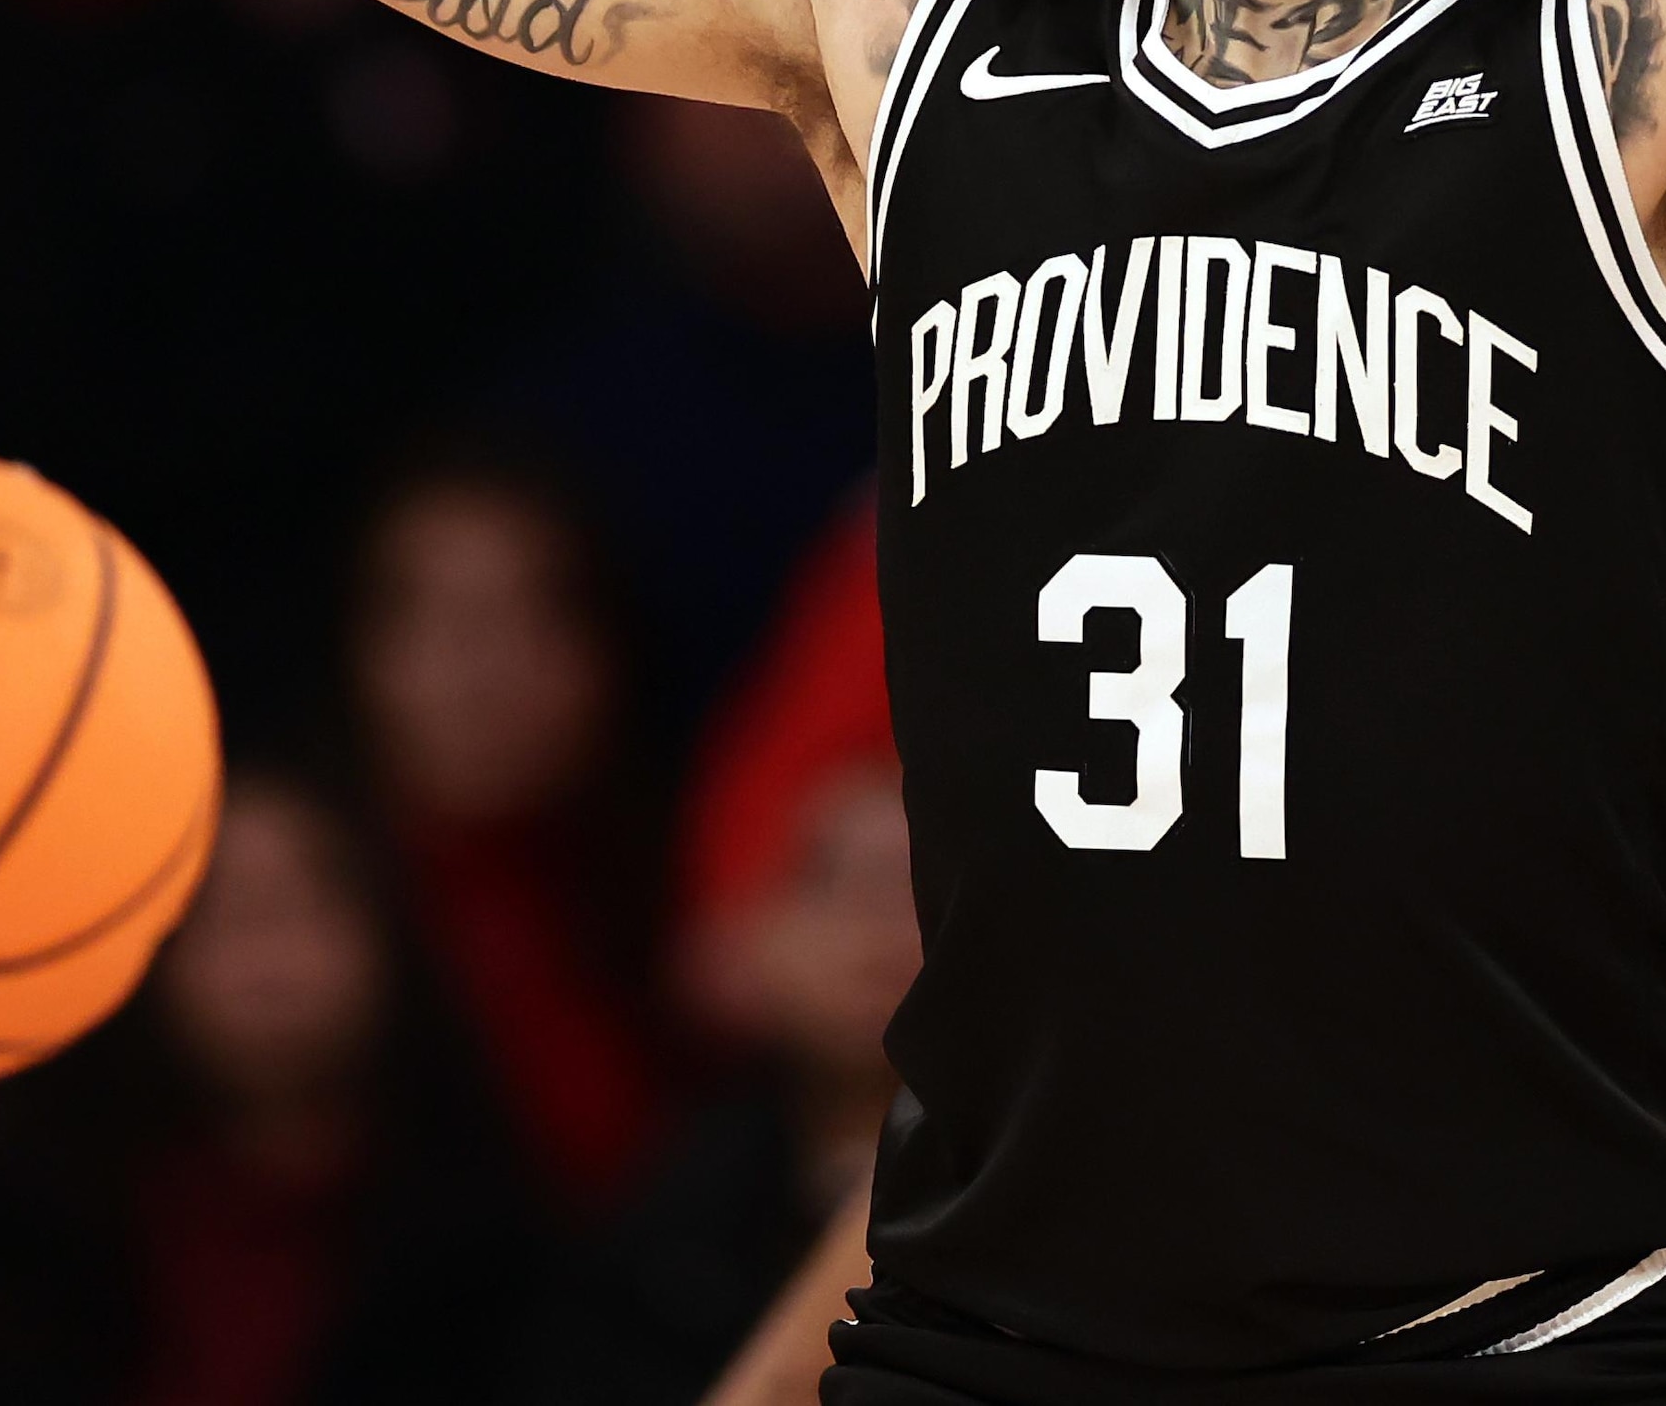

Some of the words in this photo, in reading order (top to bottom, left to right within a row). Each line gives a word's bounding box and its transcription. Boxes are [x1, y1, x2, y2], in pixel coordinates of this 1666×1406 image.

[1412, 91, 1498, 122] EAST
[1422, 73, 1484, 102] BIG
[911, 235, 1538, 535] PROVIDENCE
[1035, 554, 1293, 860] 31
